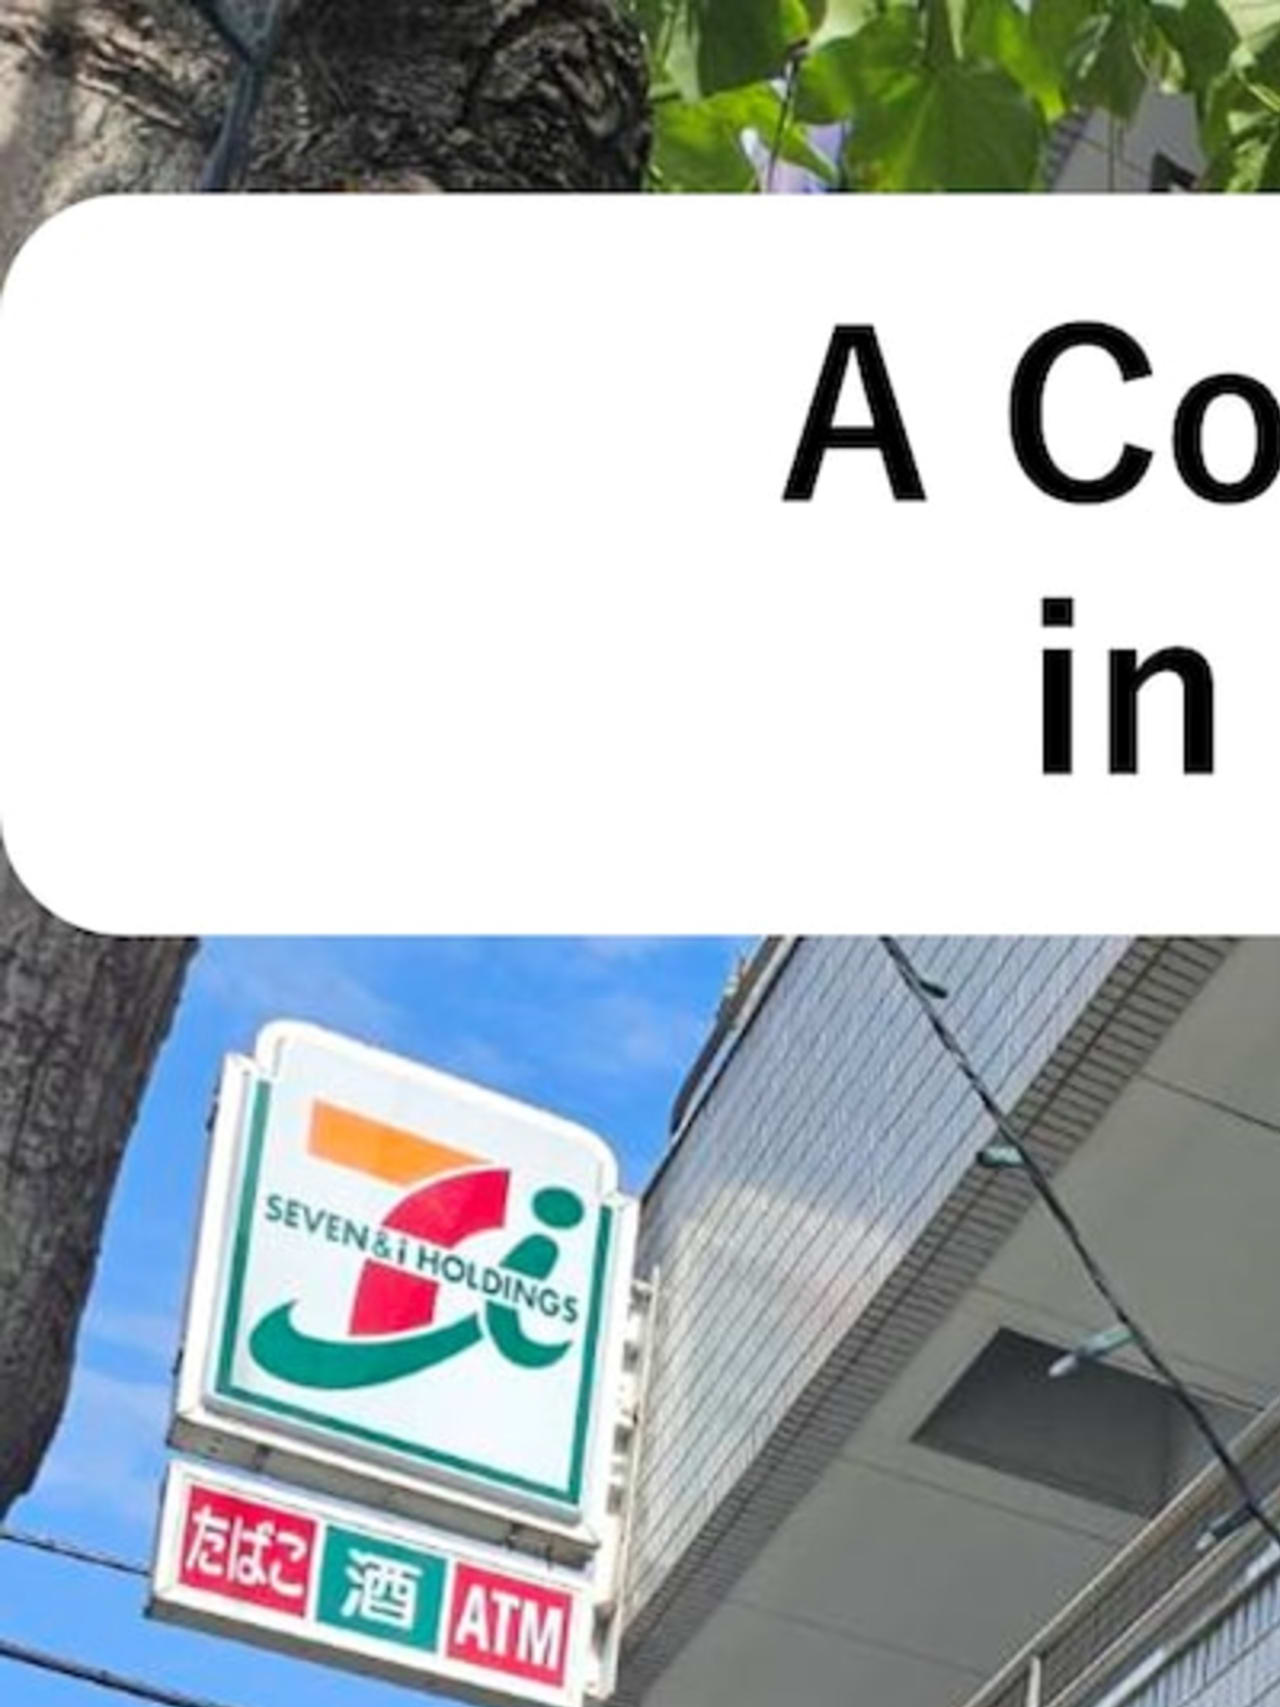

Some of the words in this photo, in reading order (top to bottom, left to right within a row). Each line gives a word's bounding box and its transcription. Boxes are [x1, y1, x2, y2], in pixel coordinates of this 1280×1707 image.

[417, 1246, 580, 1325] HOLDINGS
[185, 1504, 305, 1598] たばこ
[341, 1547, 423, 1631] 酒
[453, 1584, 564, 1671] ATM
